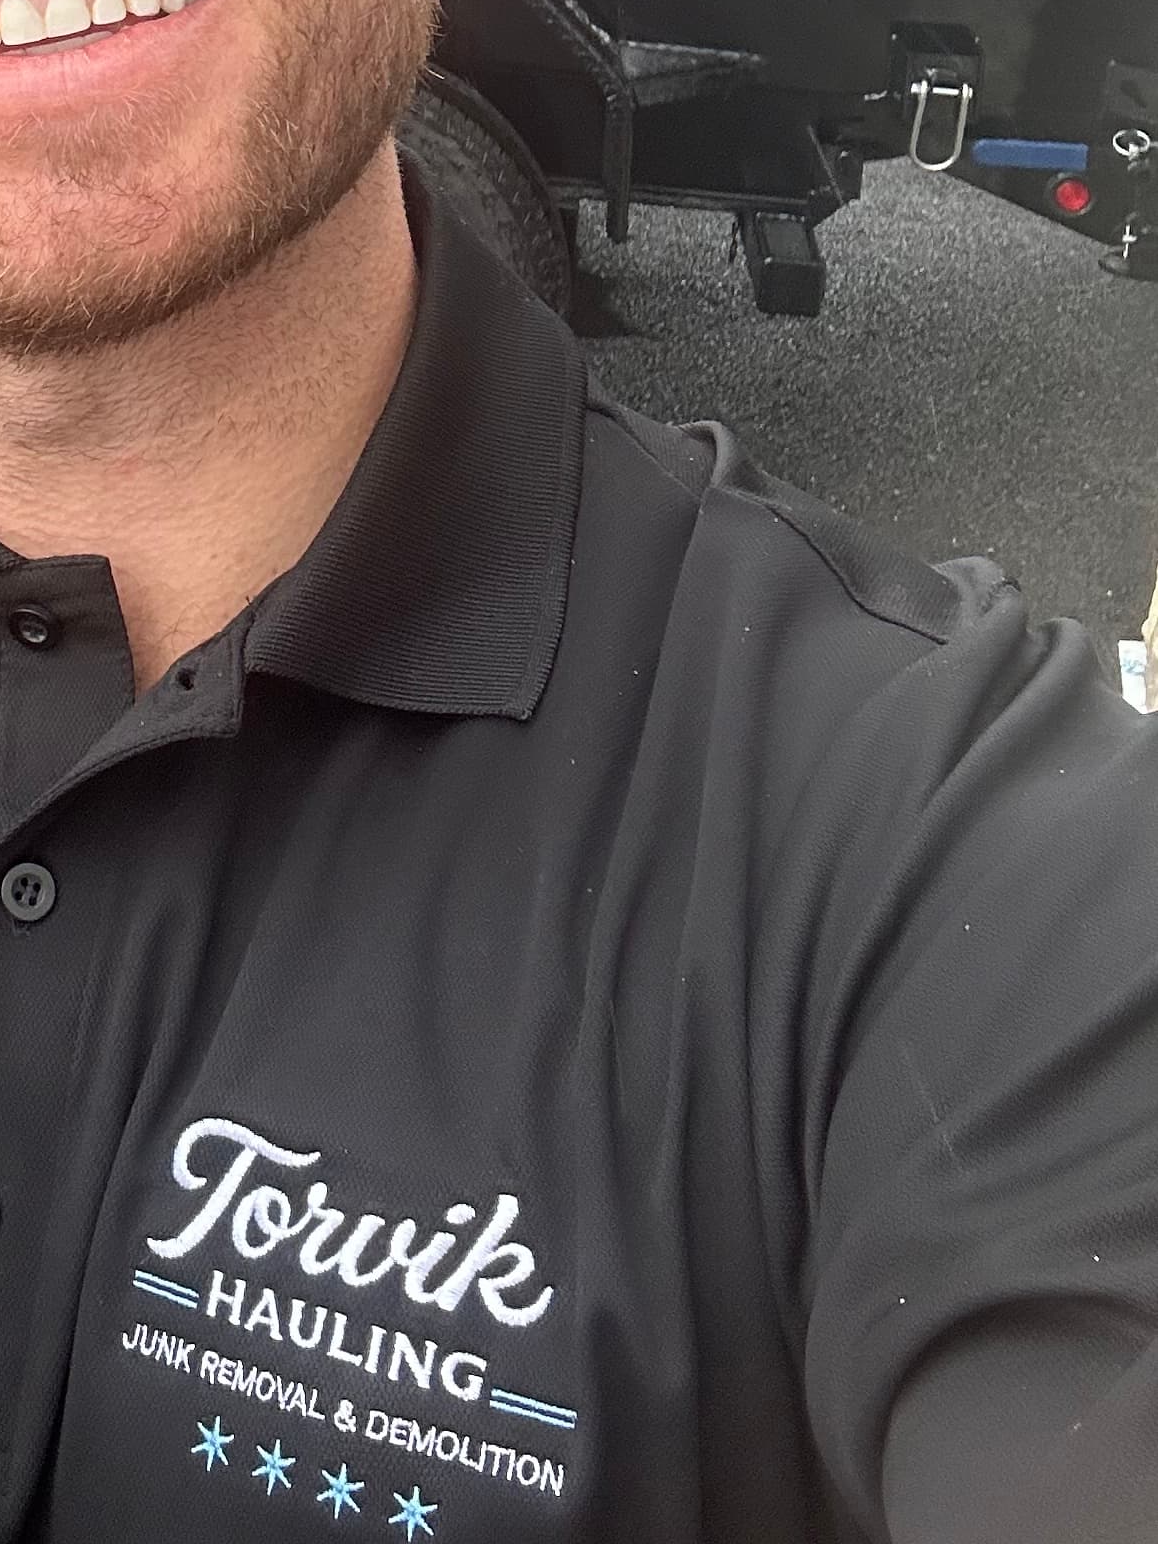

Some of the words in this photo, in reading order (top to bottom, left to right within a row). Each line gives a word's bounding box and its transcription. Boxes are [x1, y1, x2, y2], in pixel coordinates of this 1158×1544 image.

[147, 1117, 554, 1327] Torvik
[121, 1323, 196, 1373] JUNK
[199, 1350, 326, 1422] REMOVAL
[333, 1399, 357, 1433] &
[365, 1409, 567, 1496] DEMOLITION
[205, 1269, 487, 1402] HAULING
